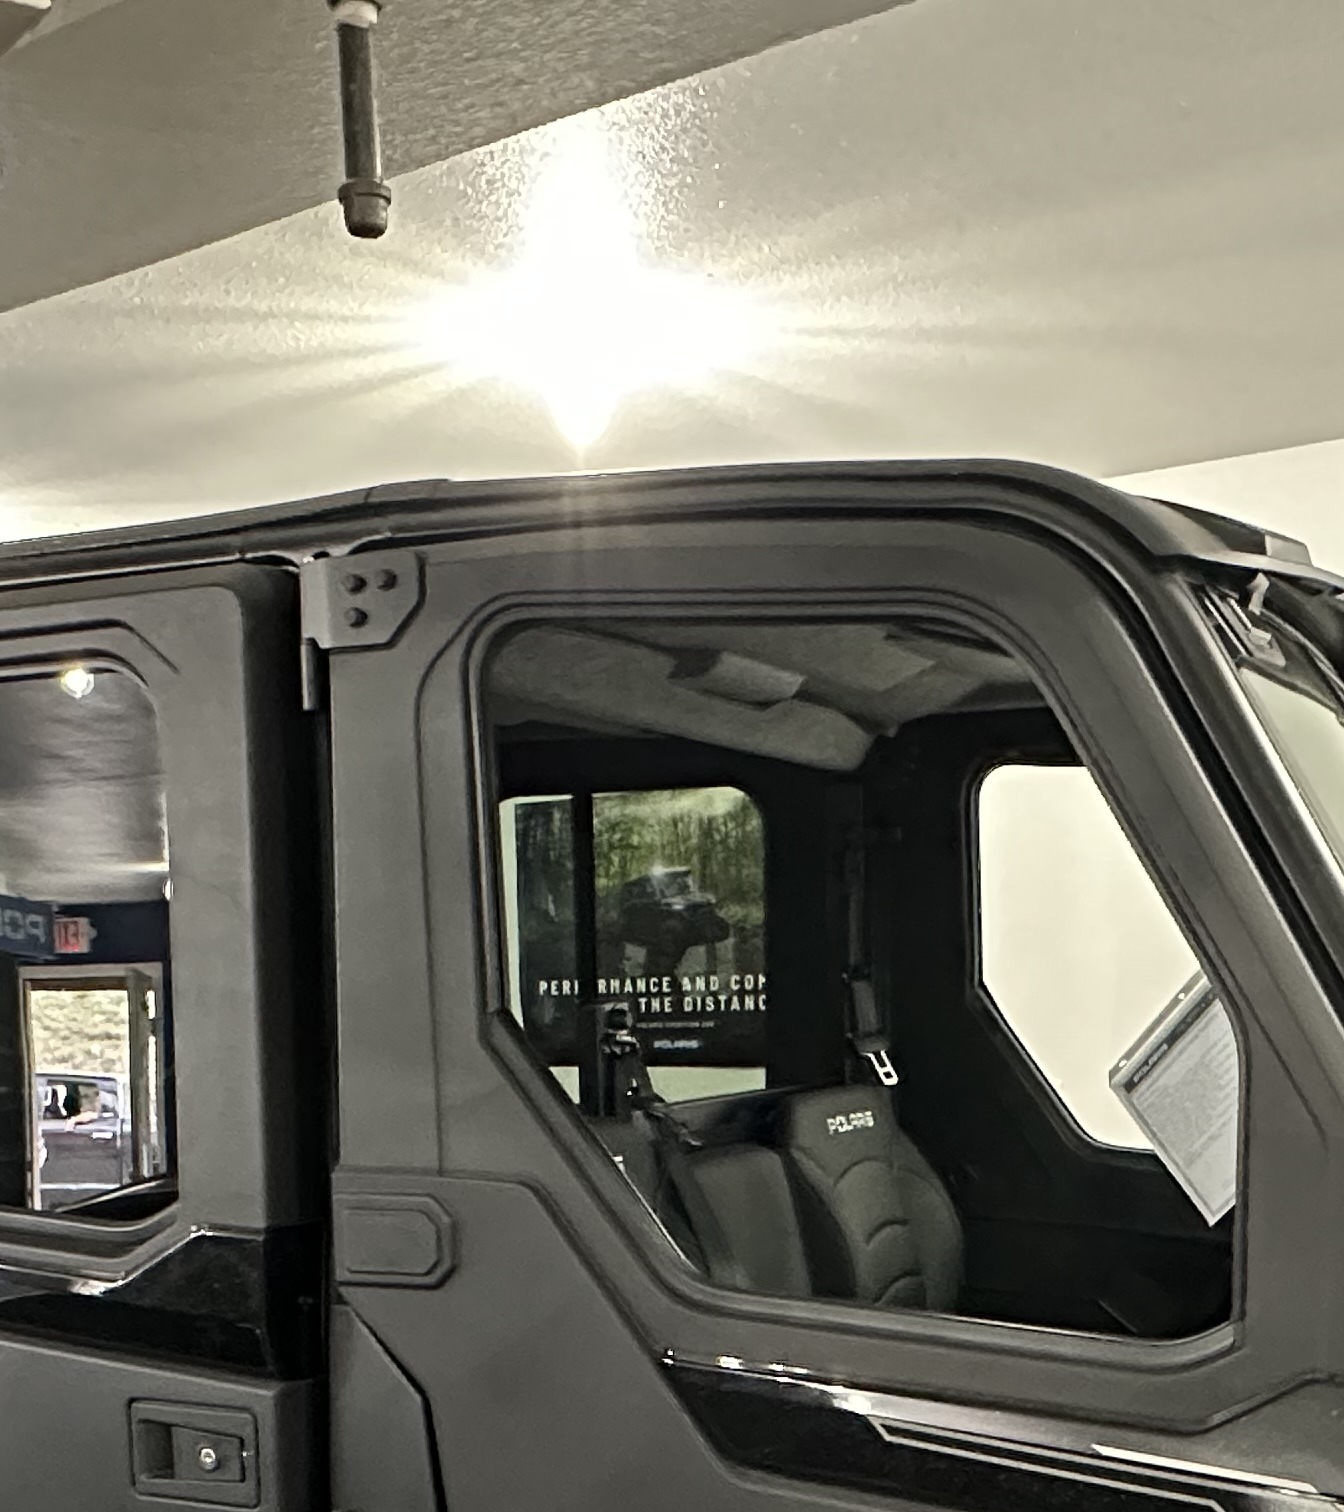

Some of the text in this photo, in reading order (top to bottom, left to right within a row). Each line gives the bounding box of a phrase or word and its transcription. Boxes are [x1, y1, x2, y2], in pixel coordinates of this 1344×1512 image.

[539, 976, 672, 996] PERRMANCE
[682, 975, 719, 993] AND
[638, 996, 673, 1014] THE
